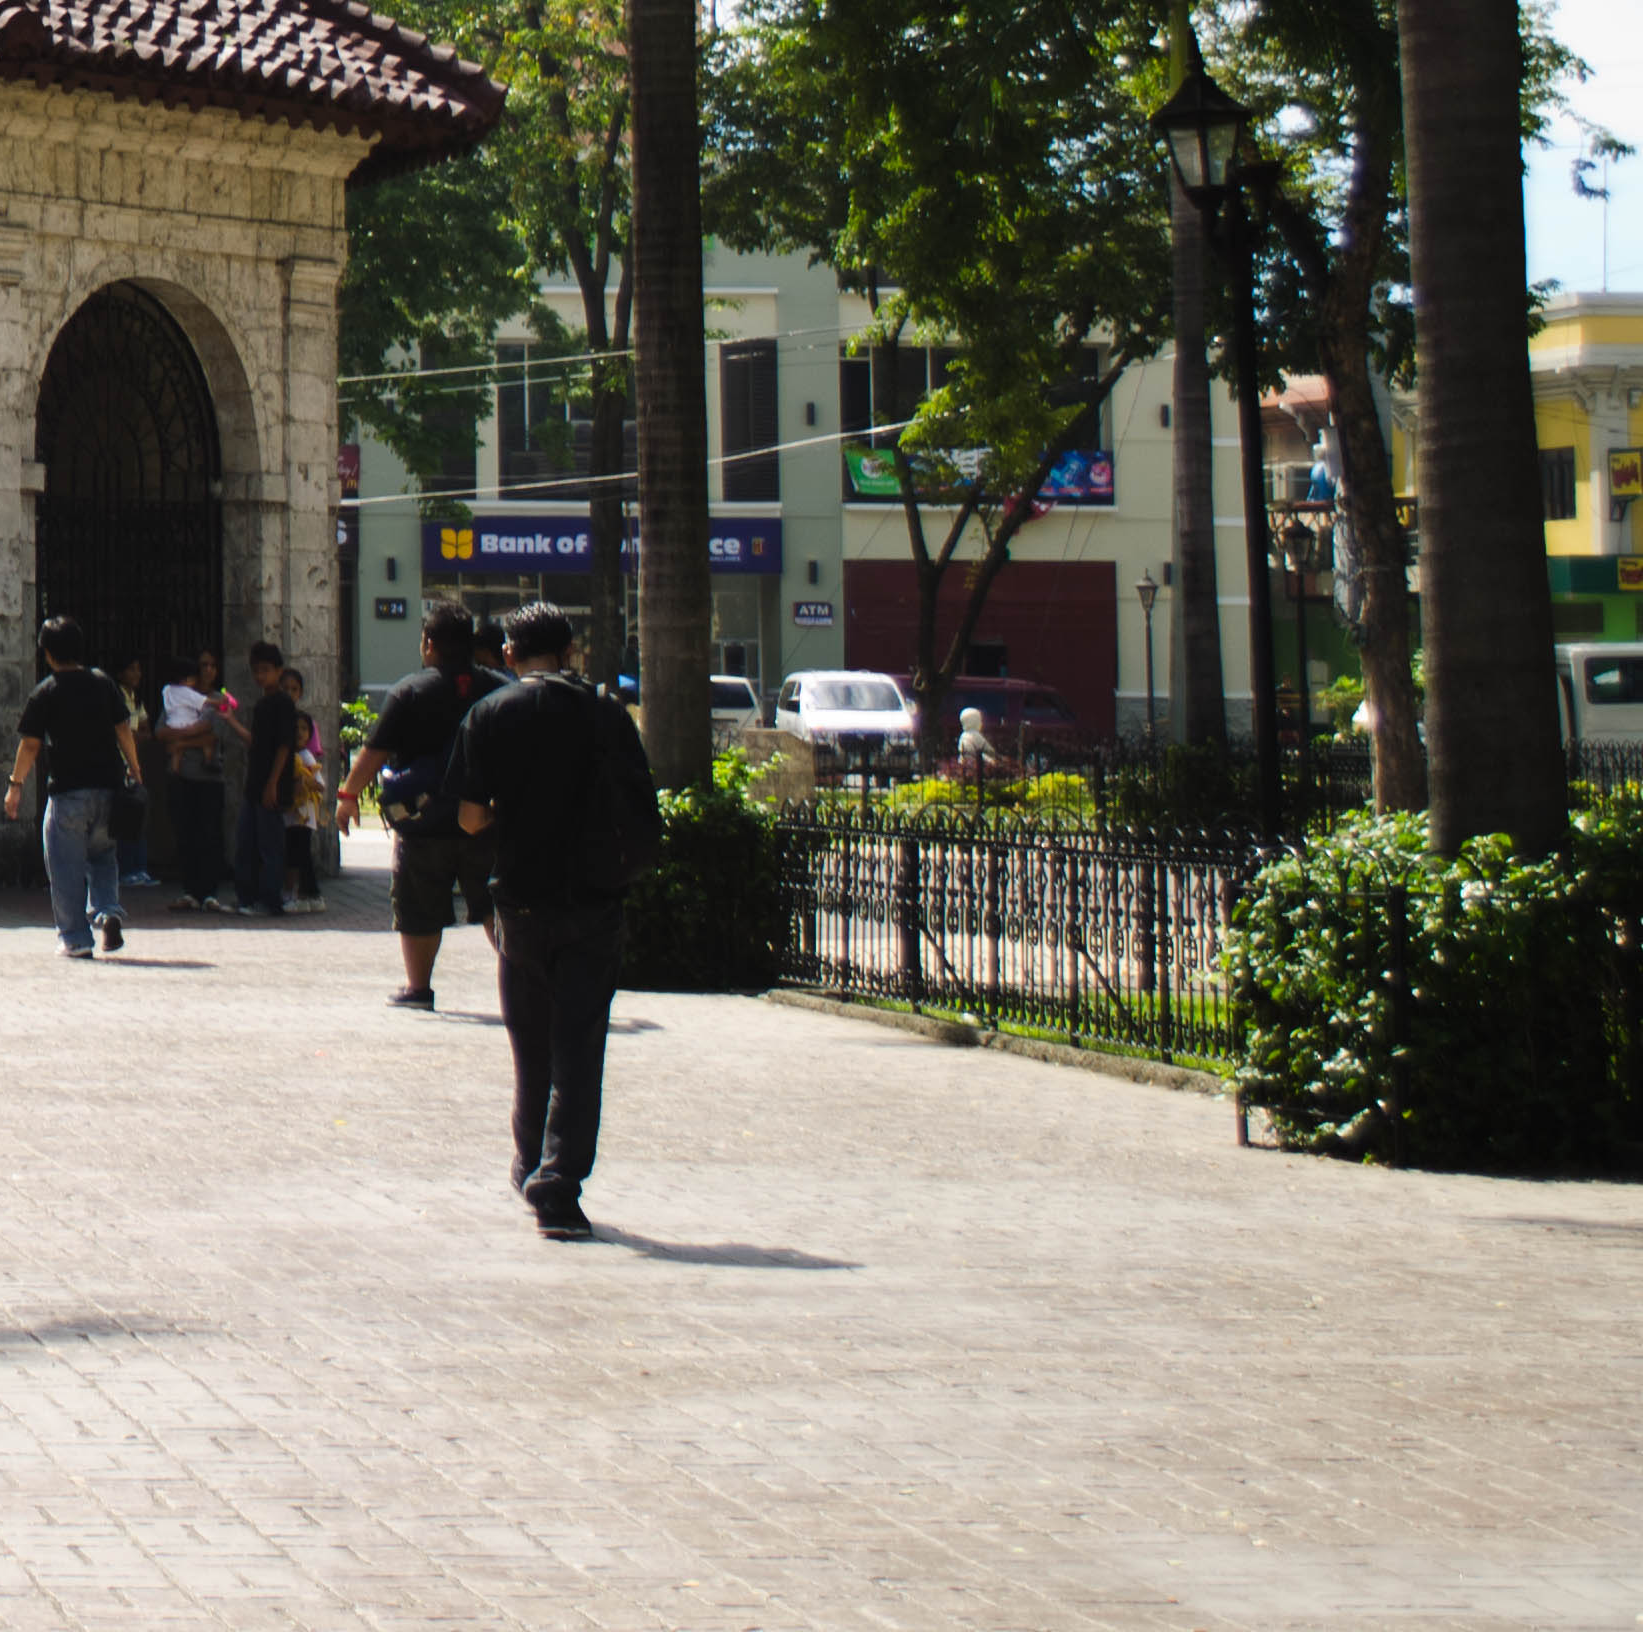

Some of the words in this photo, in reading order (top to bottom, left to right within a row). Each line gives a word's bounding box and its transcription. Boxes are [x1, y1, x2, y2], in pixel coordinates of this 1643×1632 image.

[480, 533, 553, 555] Bank
[556, 533, 588, 555] of
[799, 604, 830, 616] ATM
